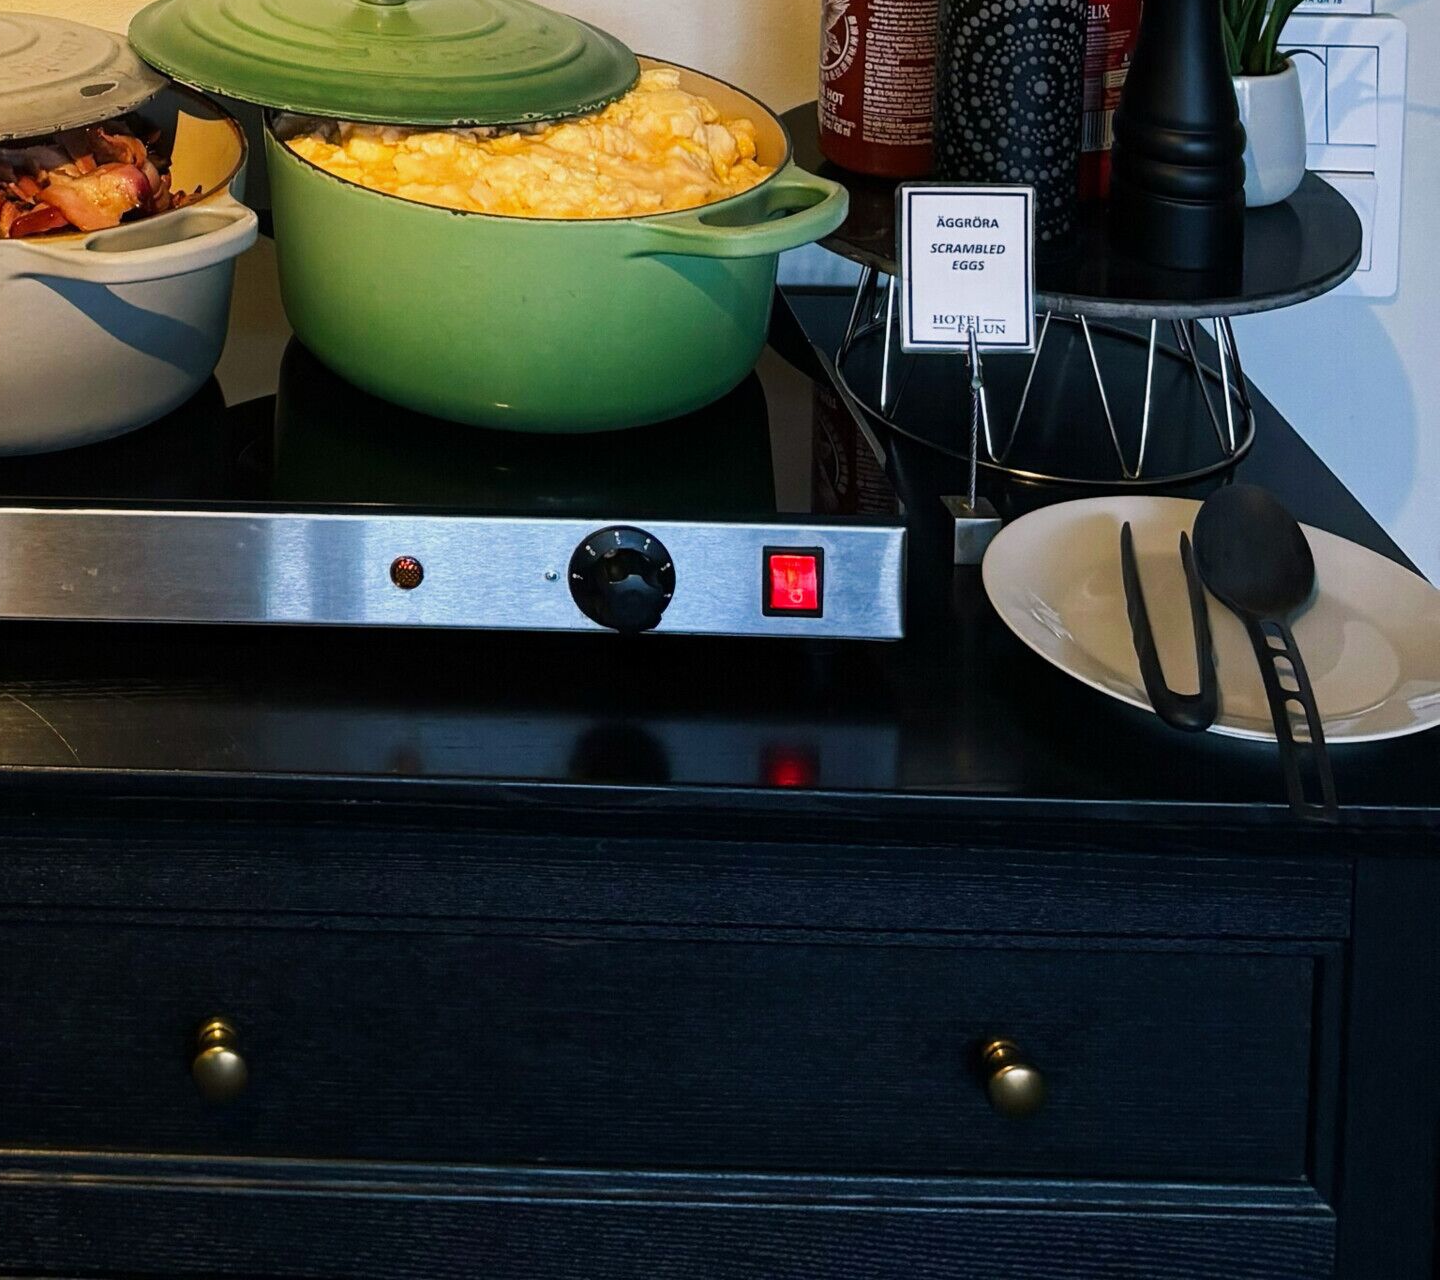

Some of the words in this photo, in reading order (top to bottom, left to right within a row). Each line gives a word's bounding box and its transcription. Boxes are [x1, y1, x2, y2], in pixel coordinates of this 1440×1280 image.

[936, 215, 1000, 229] ÄGGRÖRA
[930, 243, 1006, 255] SCRAMBLED
[951, 260, 986, 271] EGGS
[932, 314, 980, 328] HOTEL
